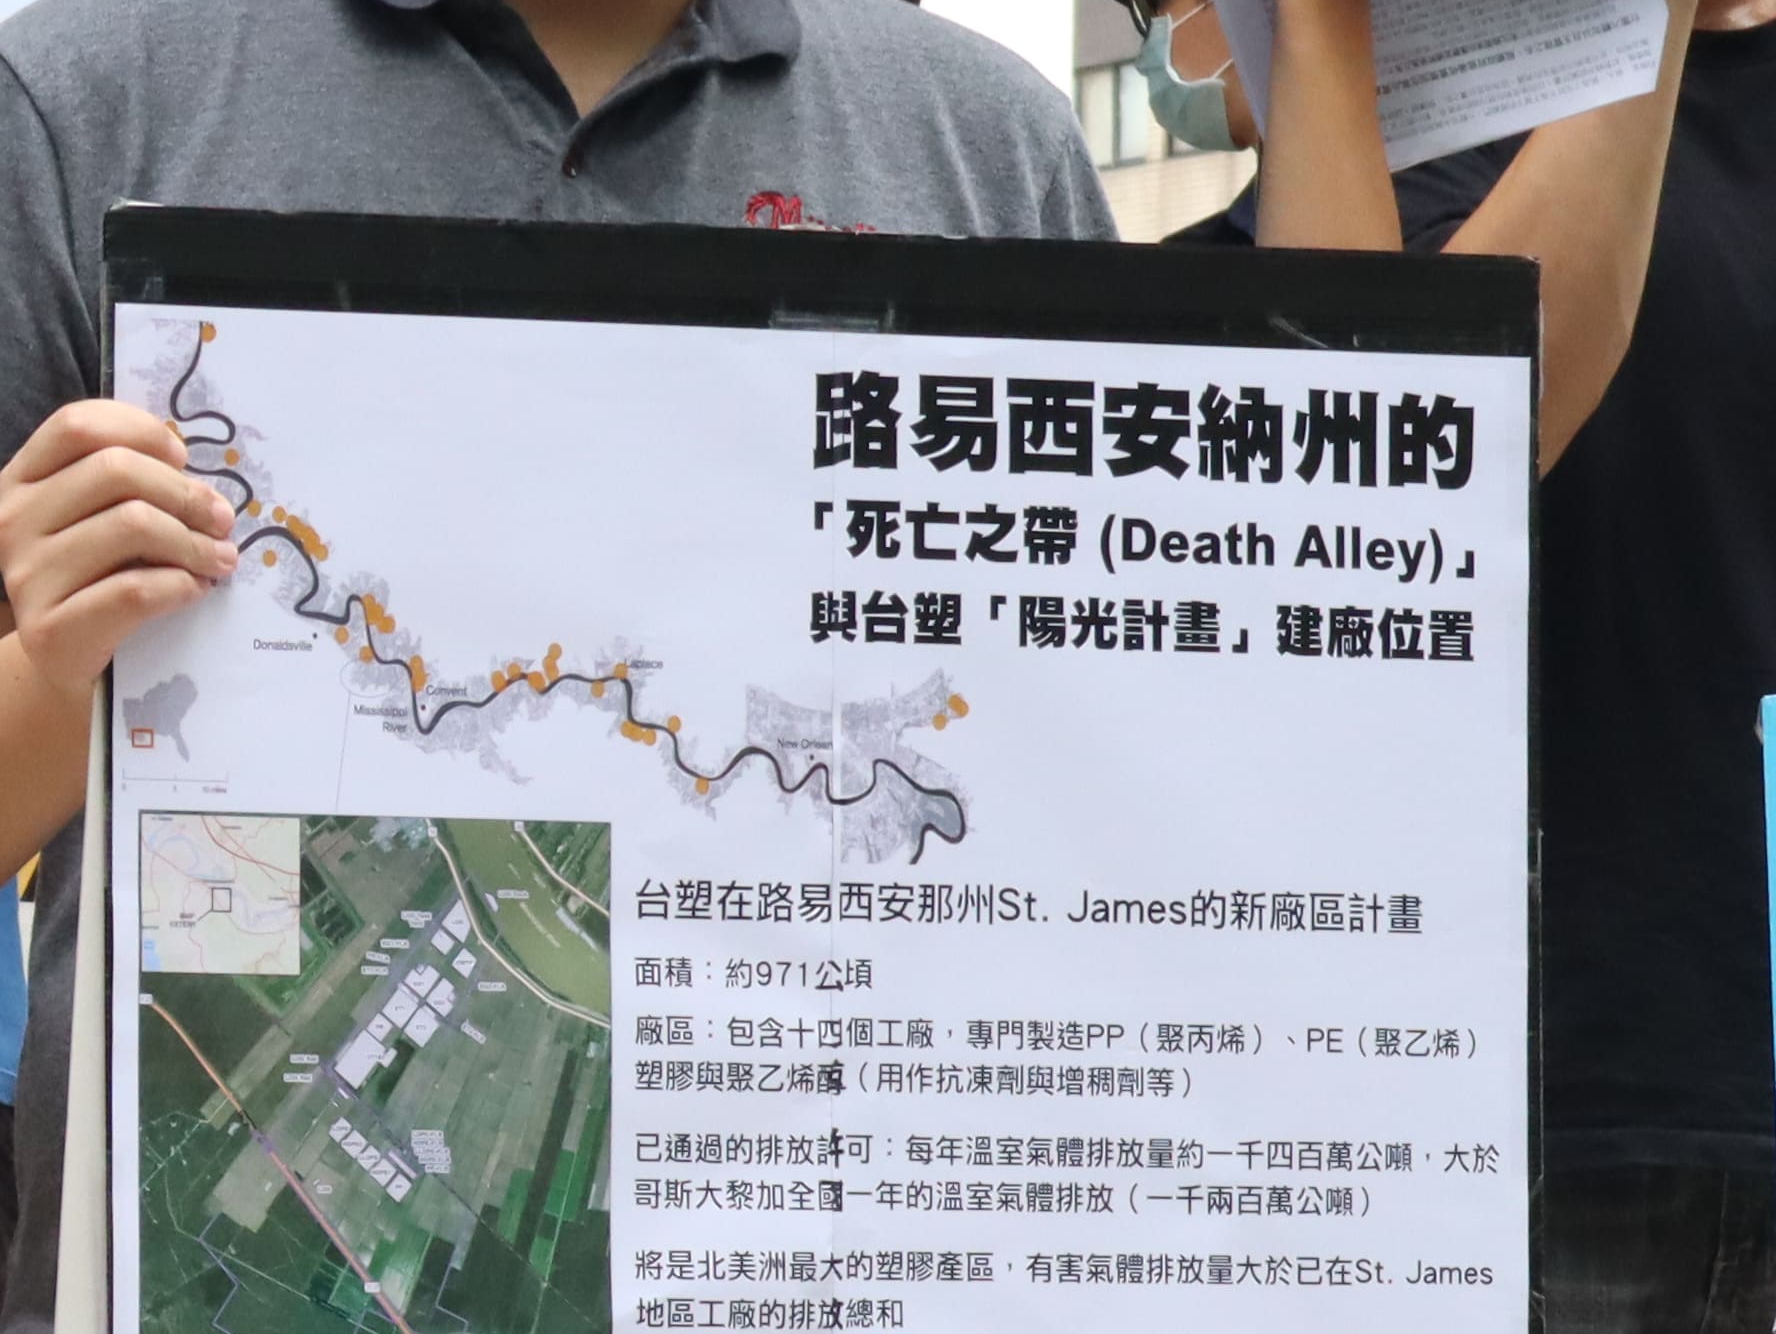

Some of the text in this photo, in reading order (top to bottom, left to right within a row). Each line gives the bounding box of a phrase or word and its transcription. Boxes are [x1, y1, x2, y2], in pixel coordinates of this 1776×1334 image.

[813, 370, 1475, 490] 路易西安納州的
[382, 721, 408, 734] River
[636, 1296, 904, 1330] 地區工廠的排放總和
